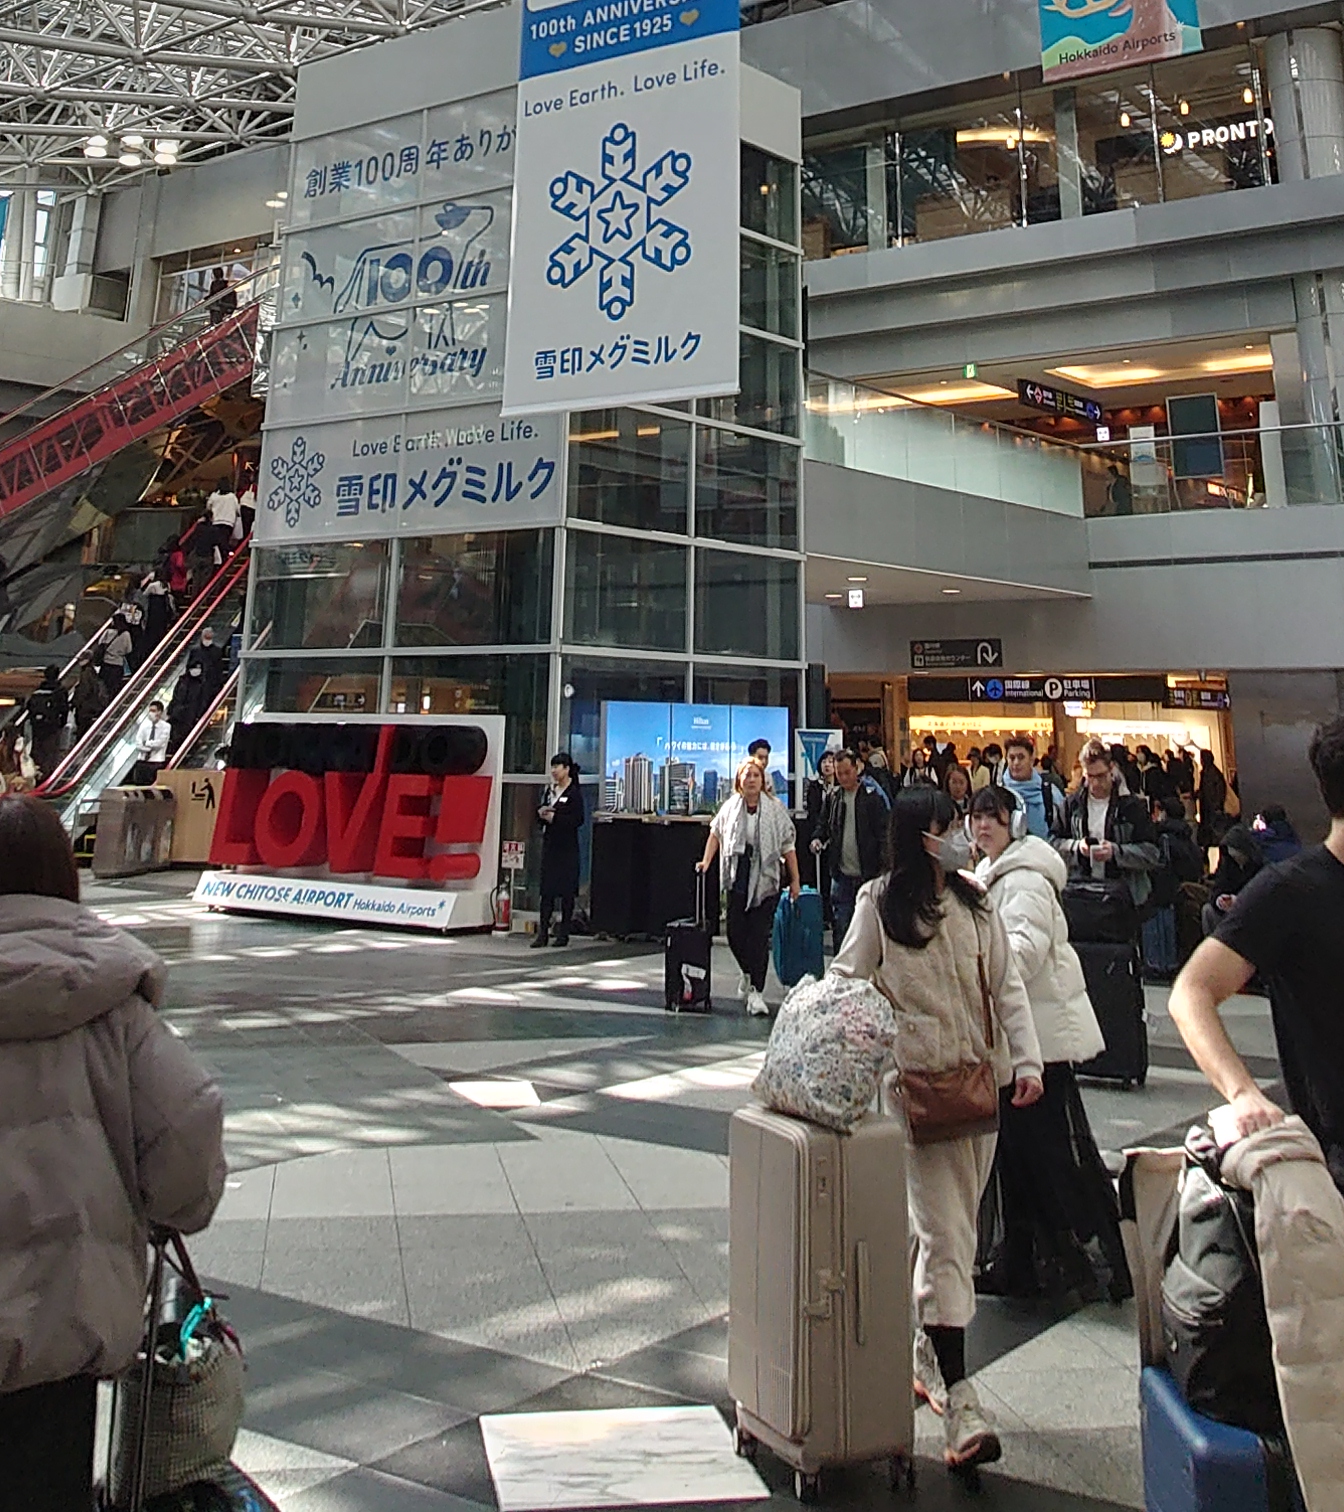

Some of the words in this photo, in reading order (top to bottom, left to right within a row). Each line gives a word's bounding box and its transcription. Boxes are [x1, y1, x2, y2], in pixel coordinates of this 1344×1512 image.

[530, 16, 576, 40] 100th
[574, 27, 630, 53] SINCE
[633, 15, 672, 39] 1925
[1059, 45, 1118, 64] Hokkaido
[1122, 31, 1176, 51] Airports
[524, 95, 563, 117] Love
[569, 82, 624, 107] Earth.
[634, 72, 677, 92] Love
[683, 59, 725, 83] Life.
[1187, 118, 1274, 149] PRONTO
[367, 246, 491, 308] 100th
[534, 331, 702, 380] 雪印メグミルク
[353, 439, 388, 457] Love
[500, 419, 539, 441] Life.
[337, 456, 556, 517] 雪印メグミルク
[1005, 689, 1043, 697] International
[1063, 689, 1091, 699] Parking
[202, 881, 234, 899] NEW
[235, 883, 293, 903] CHITOSE
[293, 888, 354, 909] AIRPORT
[355, 899, 395, 913] Hokkaido
[397, 902, 436, 917] Airports
